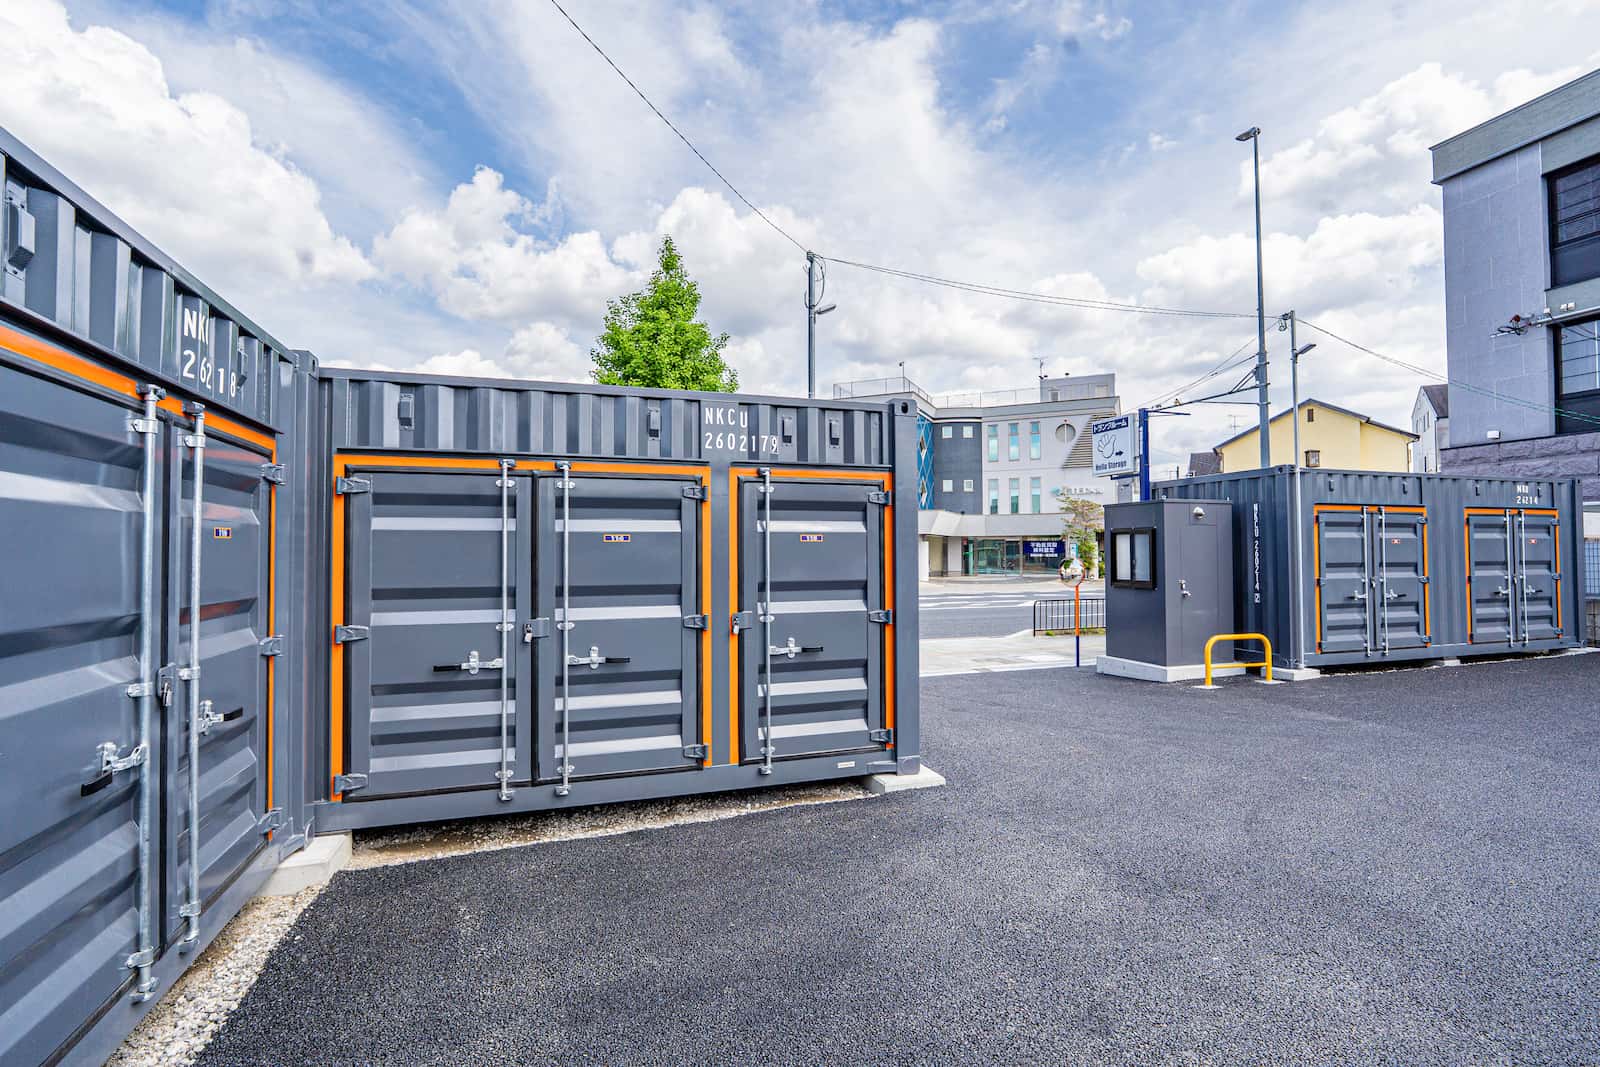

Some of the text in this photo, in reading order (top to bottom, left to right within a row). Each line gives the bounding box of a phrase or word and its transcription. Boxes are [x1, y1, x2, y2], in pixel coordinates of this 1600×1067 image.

[705, 407, 748, 428] NKCU
[1093, 417, 1127, 433] トランクルーム
[1095, 460, 1126, 471] Hello Storage
